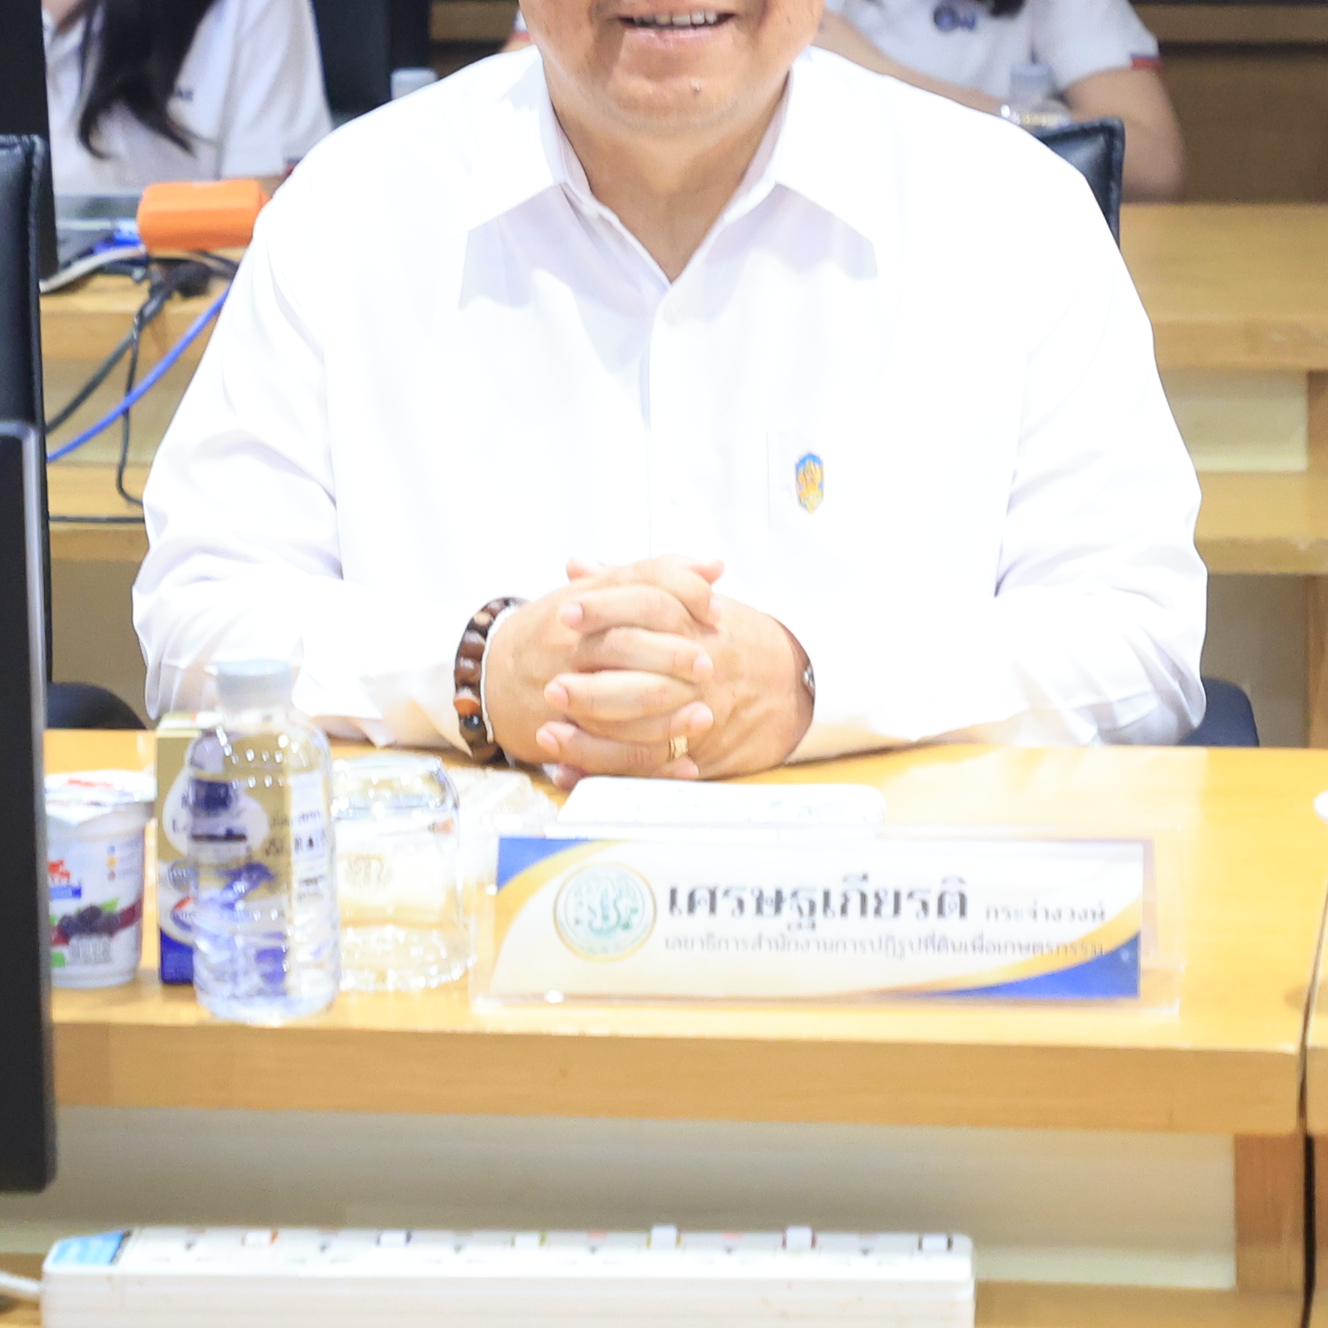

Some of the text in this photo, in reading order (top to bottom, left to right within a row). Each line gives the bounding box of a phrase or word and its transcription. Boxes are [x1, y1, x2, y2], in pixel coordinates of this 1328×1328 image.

[668, 873, 968, 933] เศรษฐเกียรติ
